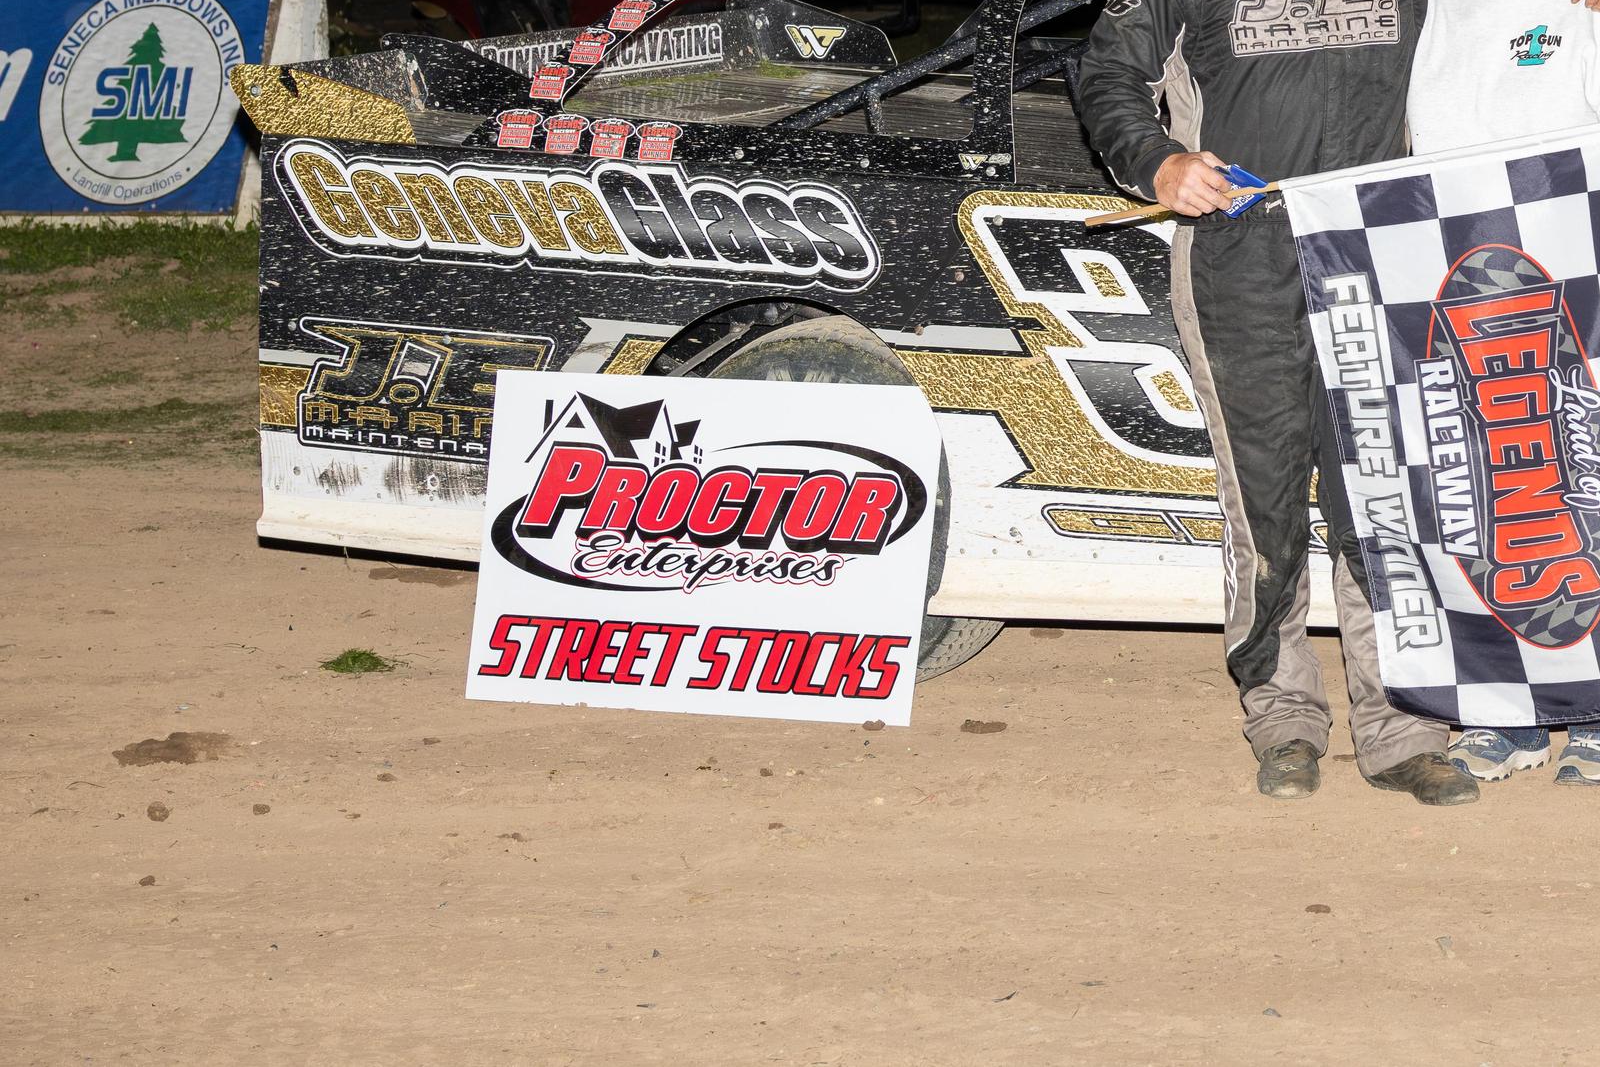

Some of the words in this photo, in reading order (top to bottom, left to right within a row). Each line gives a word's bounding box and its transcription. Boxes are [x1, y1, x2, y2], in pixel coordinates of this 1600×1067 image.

[49, 0, 119, 86] SENECA
[601, 22, 723, 70] XCAVATING
[1235, 15, 1396, 41] MARINE
[1236, 30, 1396, 51] MAINTENANCE
[1510, 33, 1533, 50] TOP
[1537, 33, 1562, 47] GUN
[91, 64, 193, 121] SMI
[641, 150, 668, 159] WINNER
[72, 168, 111, 195] Landfill
[113, 170, 182, 200] Operations
[313, 324, 547, 412] J.E
[305, 400, 494, 438] MARIN
[305, 425, 488, 454] MAINTENA
[1322, 271, 1398, 478] FEATURE
[1362, 492, 1443, 652] WINNER
[1417, 356, 1480, 558] RACEWAY
[519, 442, 902, 555] PROCTOR
[571, 534, 845, 593] Enterprises
[478, 614, 701, 684] STREET
[686, 627, 912, 702] STOCKS
